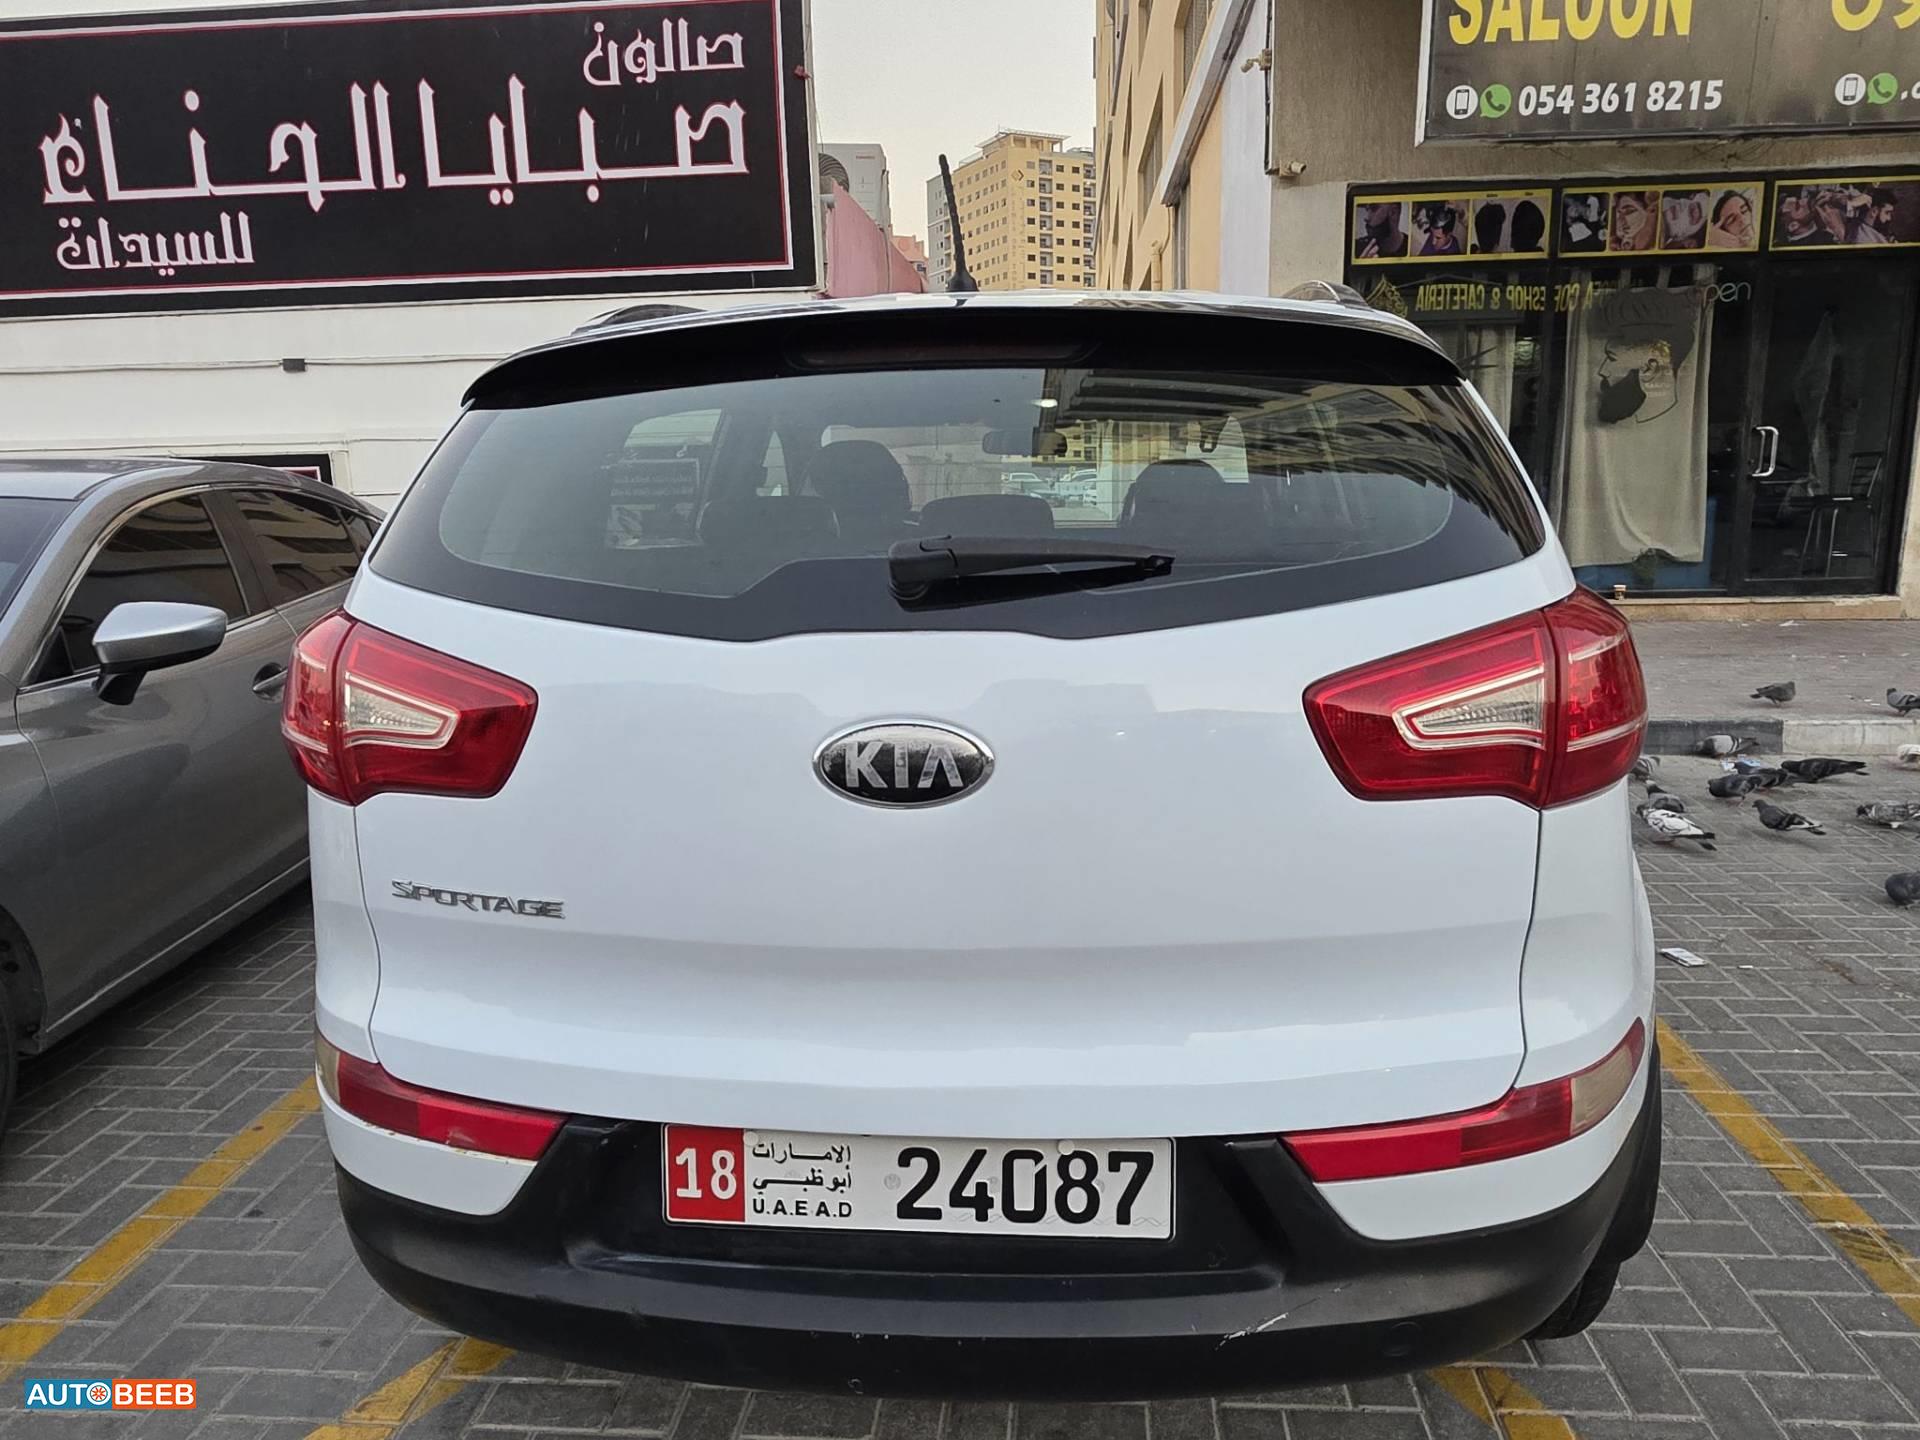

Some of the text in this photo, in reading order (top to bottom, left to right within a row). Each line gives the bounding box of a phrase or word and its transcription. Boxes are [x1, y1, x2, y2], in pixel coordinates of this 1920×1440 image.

[1449, 0, 1693, 45] SALOON
[584, 20, 745, 87] صالون
[1518, 80, 1724, 116] 054 361 8215
[418, 73, 751, 206] صبايا
[56, 211, 256, 277] للسيدات
[845, 740, 964, 788] KIA
[391, 879, 566, 919] SPORTAGE
[675, 1147, 738, 1201] 18
[752, 1167, 824, 1195] ظبي
[896, 1146, 1154, 1226] 24087
